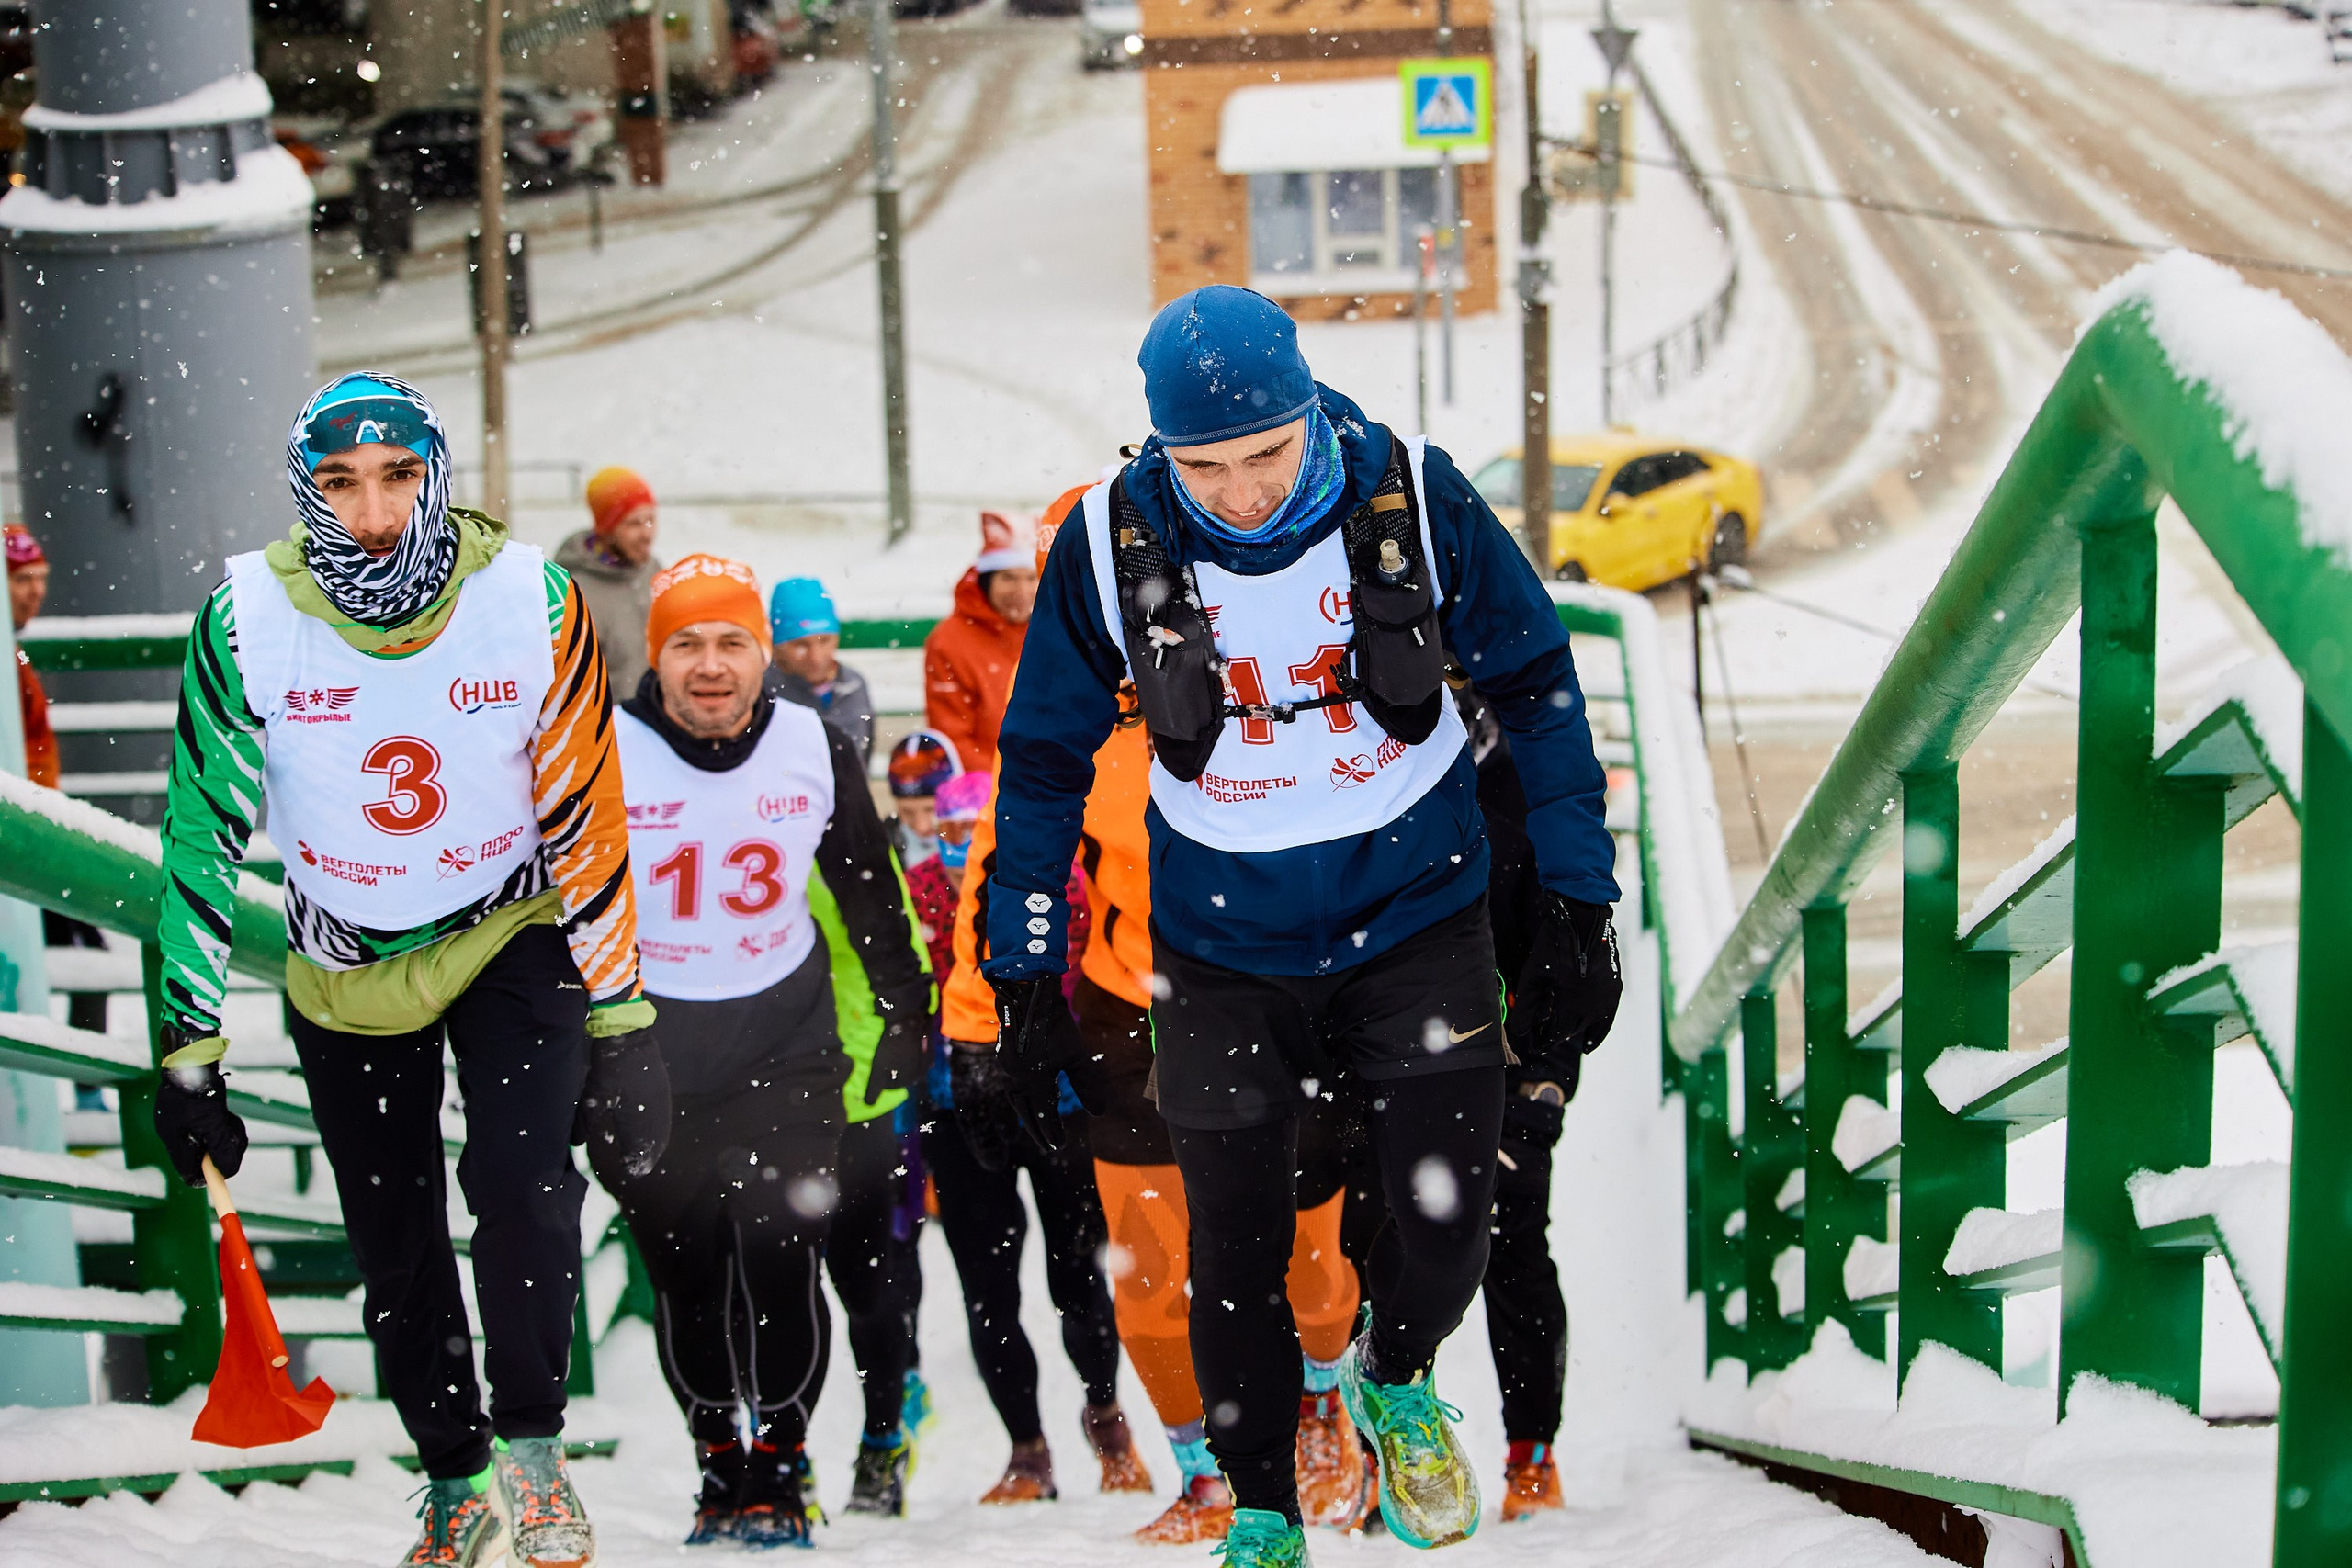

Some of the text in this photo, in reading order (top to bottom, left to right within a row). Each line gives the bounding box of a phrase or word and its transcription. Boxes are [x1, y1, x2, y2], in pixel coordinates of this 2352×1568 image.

[461, 680, 518, 705] НЦВ
[1221, 643, 1358, 745] 11
[1377, 740, 1407, 769] НЦВ
[361, 735, 447, 836] 3
[1205, 772, 1297, 791] ВЕРТОЛЕТЫ
[1205, 786, 1267, 803] РОССИИ
[481, 826, 524, 852] ППОО
[481, 841, 512, 862] НЦВ
[321, 854, 406, 876] ВЕРТОЛЕТЫ
[322, 864, 378, 886] РОССИИ
[649, 837, 789, 921] 13
